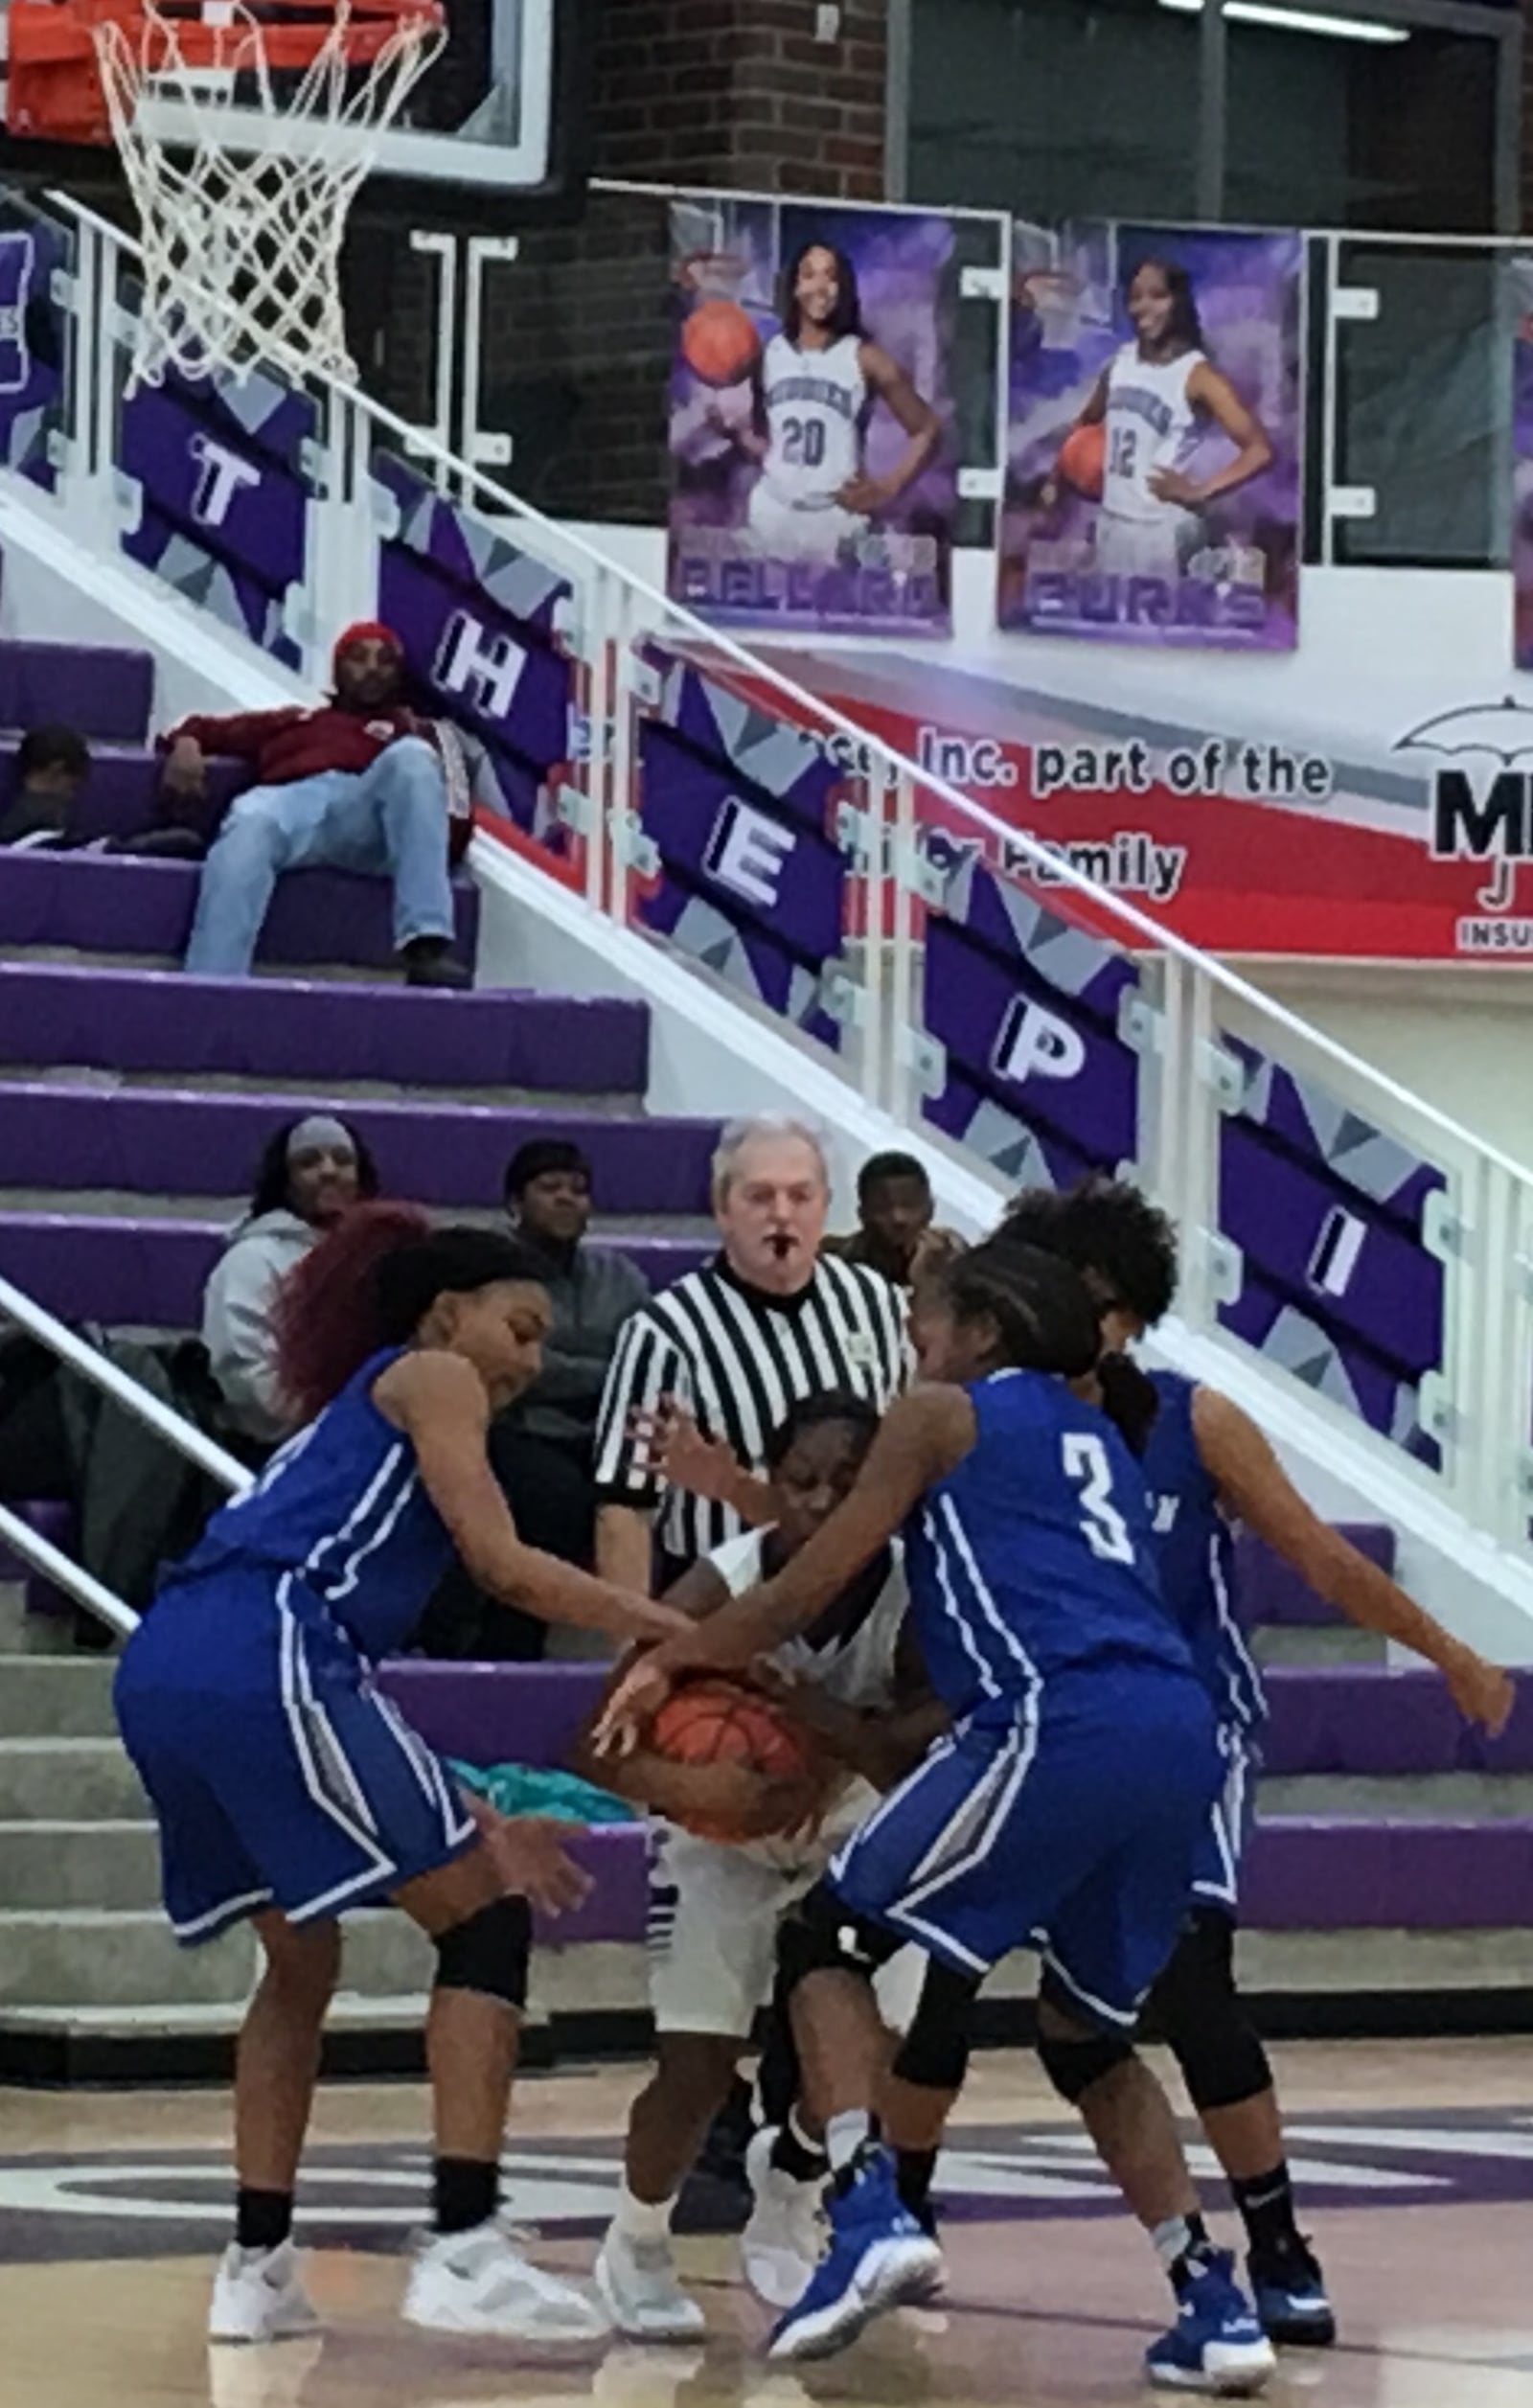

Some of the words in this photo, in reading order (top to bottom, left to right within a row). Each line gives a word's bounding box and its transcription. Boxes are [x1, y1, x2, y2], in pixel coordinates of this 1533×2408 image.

[781, 415, 826, 468] 20
[921, 730, 1014, 780] Inc.
[1038, 743, 1147, 792] part
[1168, 742, 1223, 790] of
[1243, 746, 1331, 794] the
[1436, 768, 1533, 855] M
[190, 431, 261, 526] T
[431, 608, 528, 719] H
[701, 795, 796, 907] E
[989, 993, 1085, 1083] P
[1306, 1204, 1367, 1297] I
[1005, 832, 1179, 896] Family
[1461, 921, 1531, 948] INSU
[1061, 1433, 1136, 1565] 3
